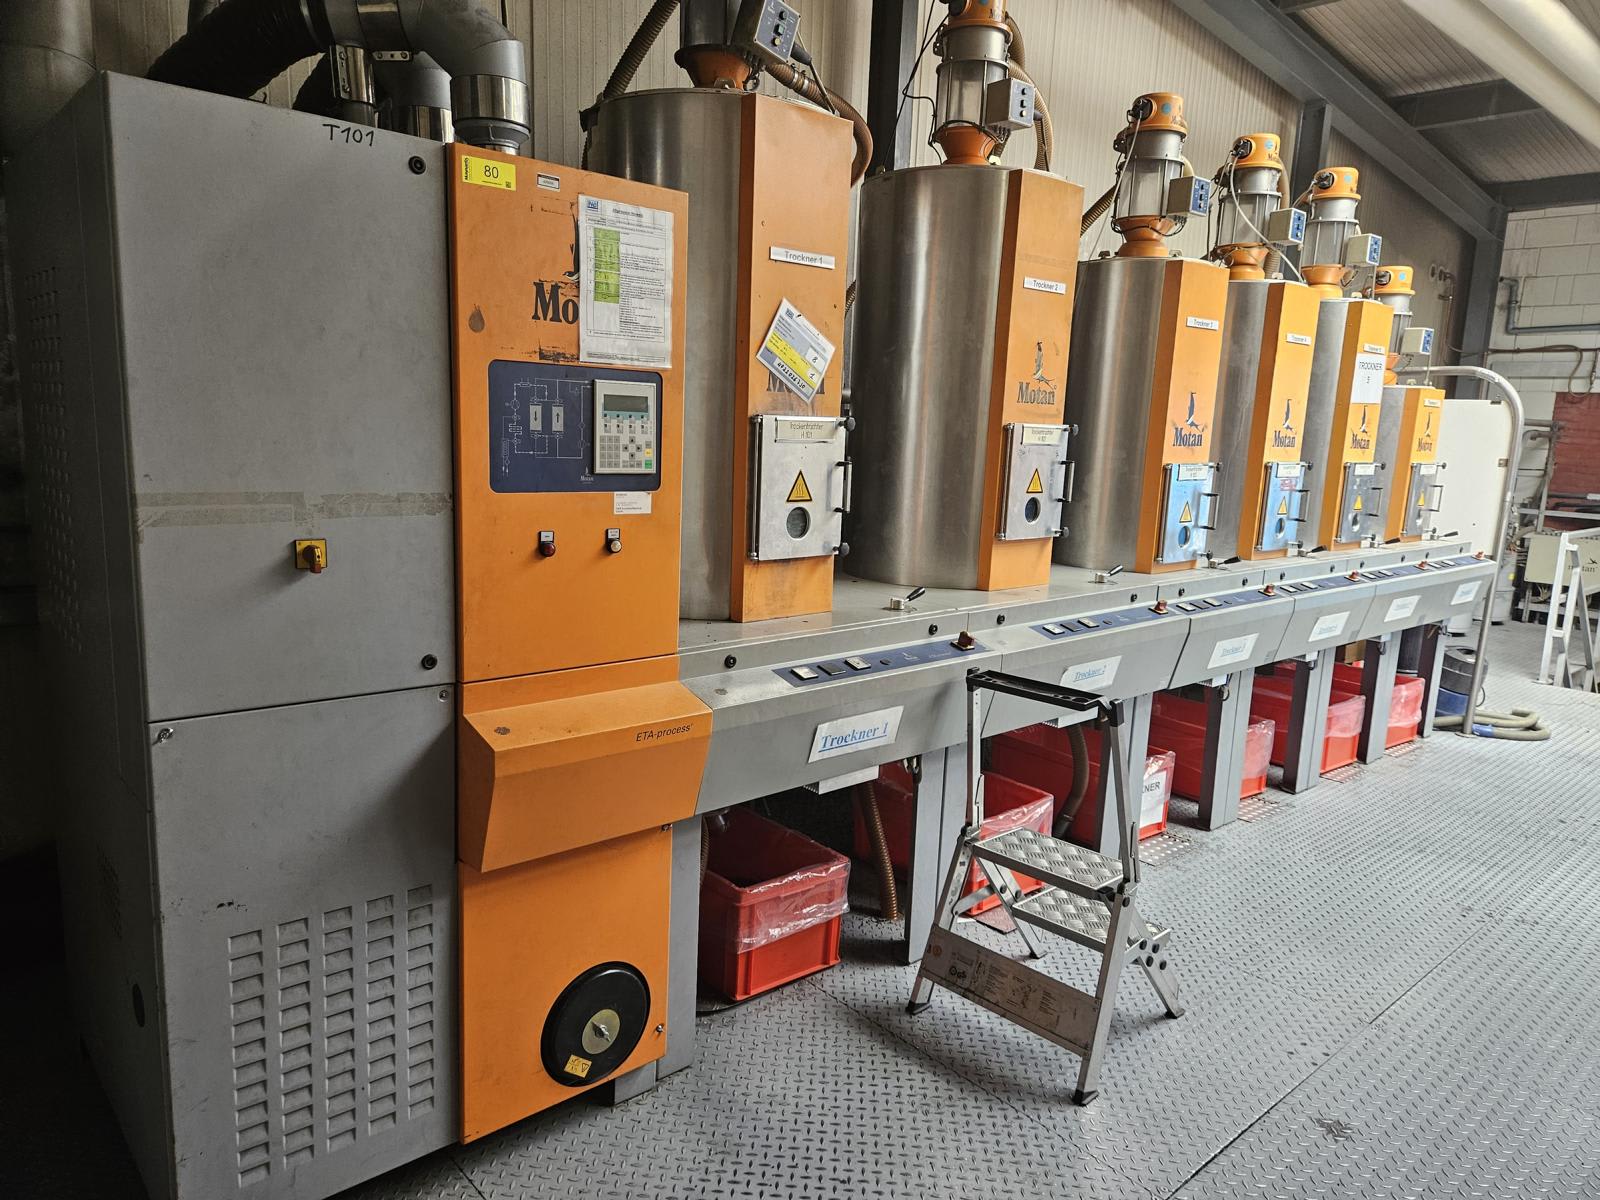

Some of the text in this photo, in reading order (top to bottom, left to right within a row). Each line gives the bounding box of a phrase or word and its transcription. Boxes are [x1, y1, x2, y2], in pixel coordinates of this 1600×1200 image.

[322, 123, 374, 147] T101
[484, 165, 499, 179] 80
[784, 250, 818, 264] Trockner
[1173, 427, 1203, 447] Motan
[1272, 430, 1296, 448] Motan
[821, 726, 880, 749] Trockner
